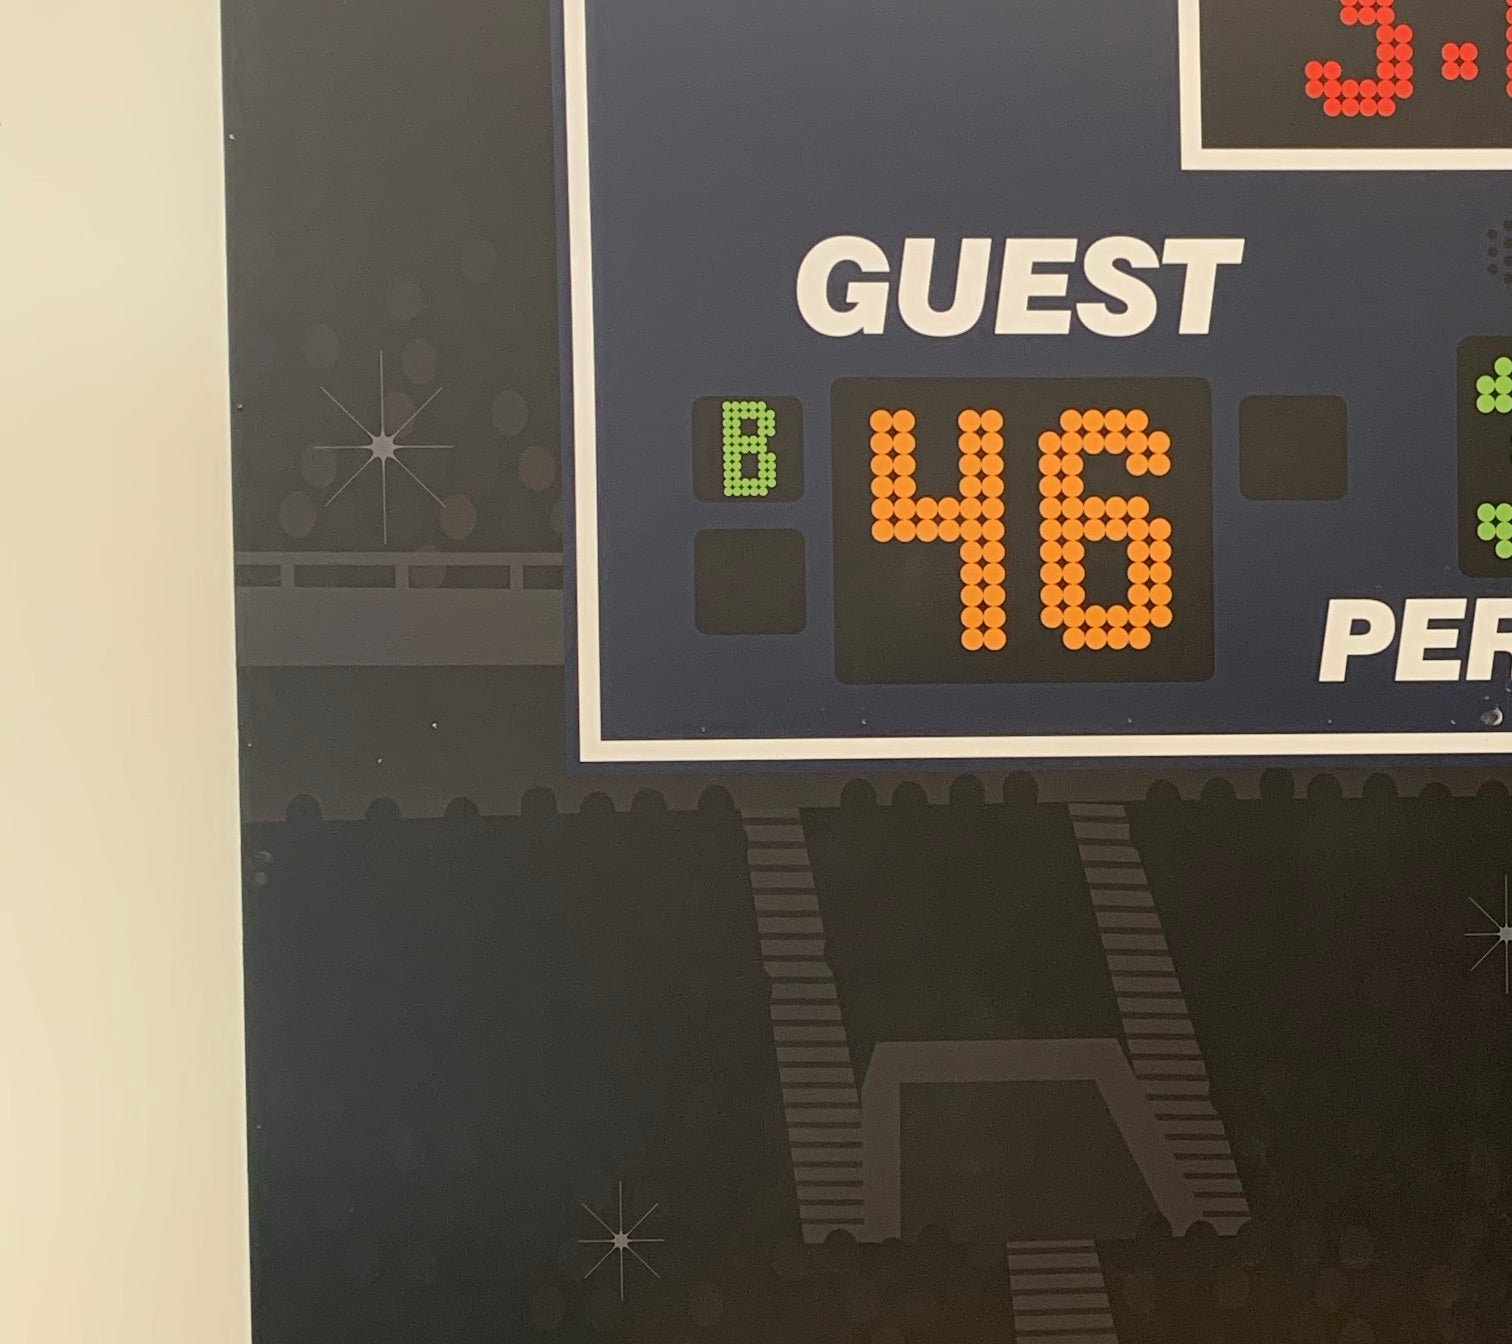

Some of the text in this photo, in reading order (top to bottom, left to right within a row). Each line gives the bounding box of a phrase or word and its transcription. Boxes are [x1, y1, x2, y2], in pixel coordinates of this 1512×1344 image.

[796, 236, 1246, 338] GUEST
[722, 400, 777, 498] B
[869, 408, 1173, 651] 46
